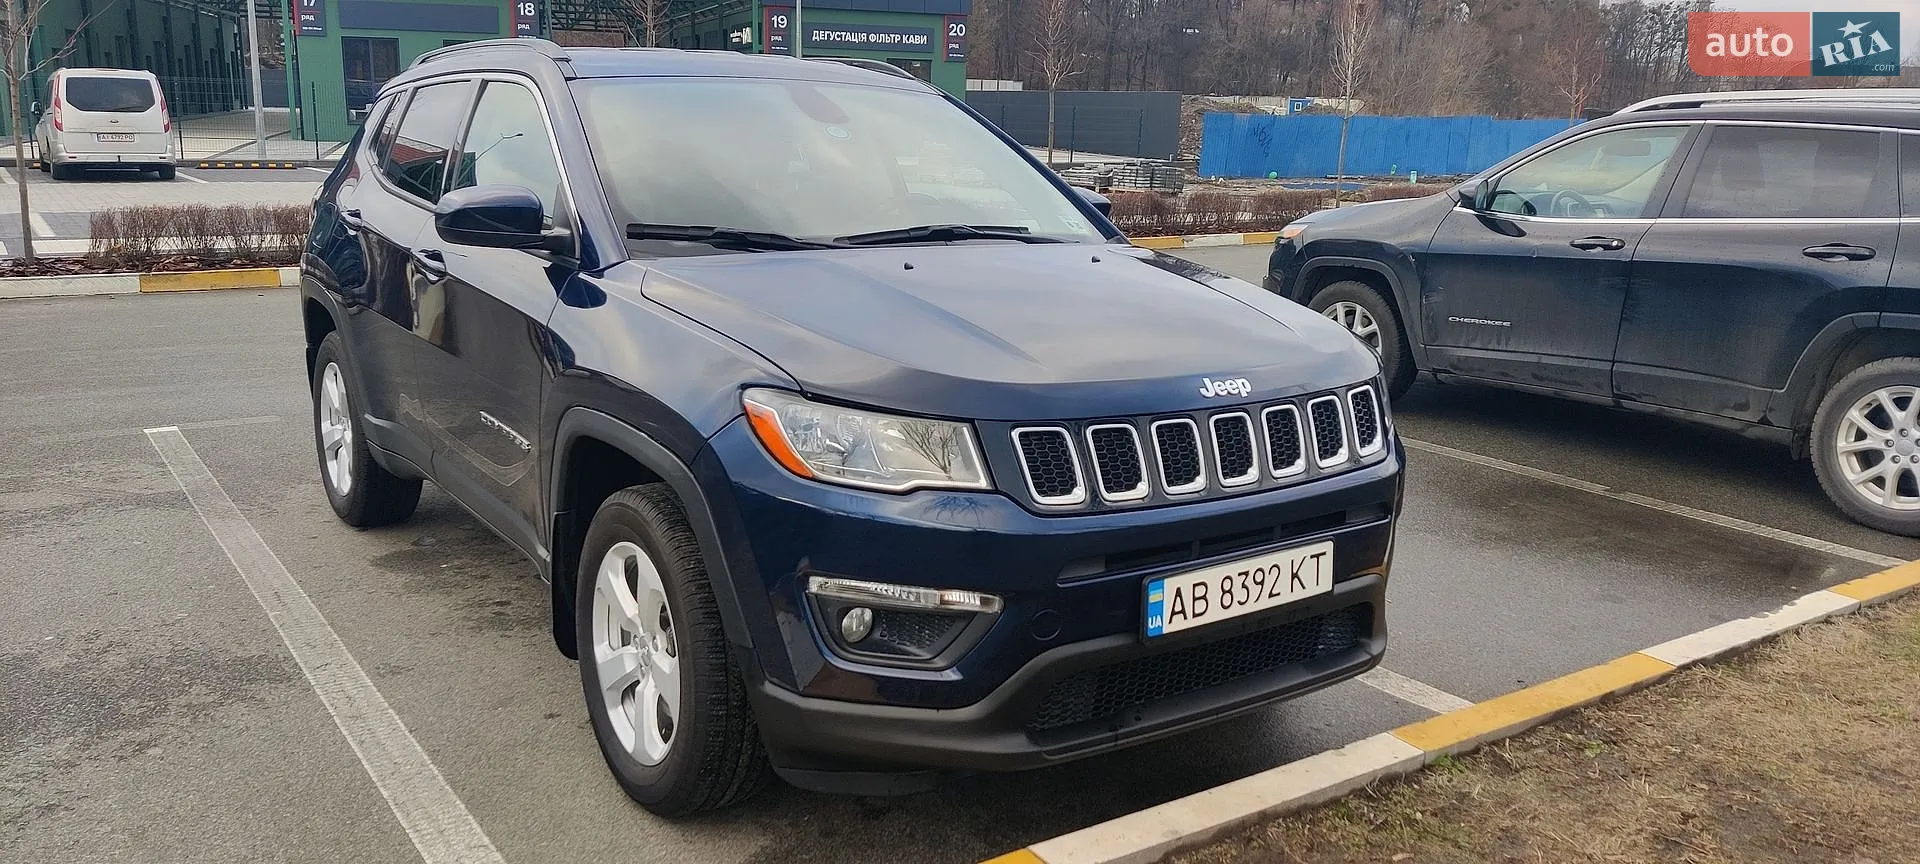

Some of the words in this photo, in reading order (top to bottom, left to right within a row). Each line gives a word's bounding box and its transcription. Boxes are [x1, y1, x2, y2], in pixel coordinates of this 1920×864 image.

[517, 2, 535, 16] 18
[771, 15, 788, 28] 19
[949, 23, 966, 36] 20
[812, 30, 867, 43] ДЕГУСТАЦІЯ
[868, 33, 901, 43] ФІЛЬТР
[902, 34, 927, 45] КАВИ
[1448, 316, 1511, 326] CHEROKEE
[1200, 377, 1252, 398] Jeep
[1168, 581, 1209, 625] AB
[1220, 563, 1281, 610] 8392
[1290, 551, 1328, 593] KT
[1148, 616, 1163, 629] UA
